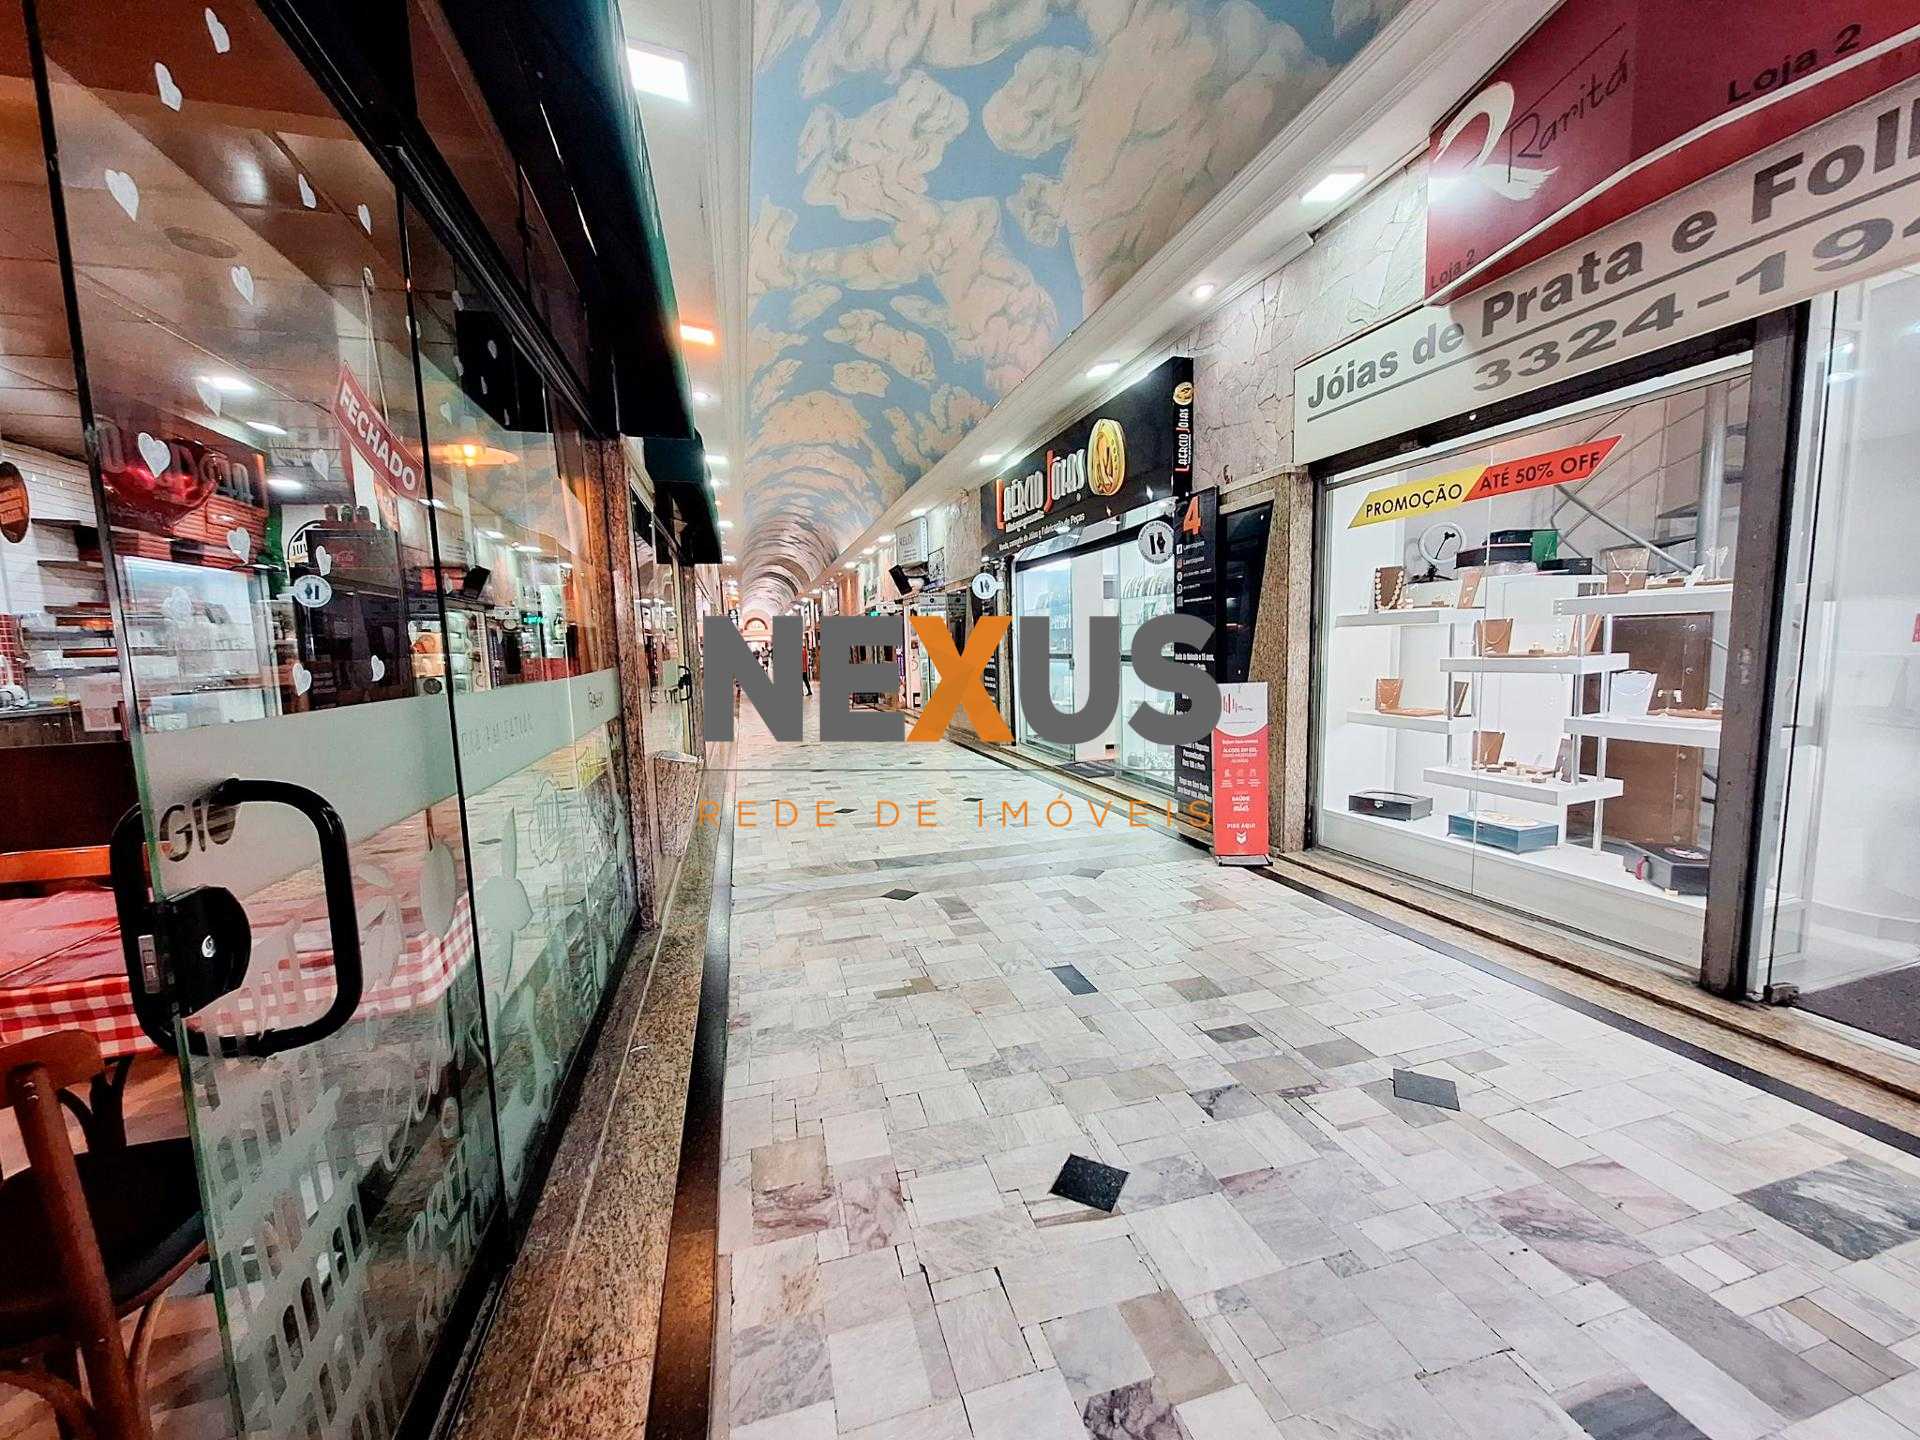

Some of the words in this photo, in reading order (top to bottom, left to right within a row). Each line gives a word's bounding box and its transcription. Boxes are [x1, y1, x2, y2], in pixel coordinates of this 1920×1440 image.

[1728, 50, 1818, 103] Loja
[1834, 23, 1862, 54] 2
[1430, 259, 1462, 290] Loja
[1466, 248, 1475, 269] 2
[1307, 350, 1399, 410] Jóias
[1412, 322, 1465, 365] de
[1481, 239, 1645, 338] Prata
[1671, 210, 1718, 254] e
[338, 381, 417, 492] FECHADO
[1183, 495, 1200, 535] 4
[1364, 483, 1463, 519] PROMOÇÃO
[1479, 467, 1510, 491] ATÉ
[1515, 461, 1554, 484] 50%
[1561, 451, 1601, 474] OFF
